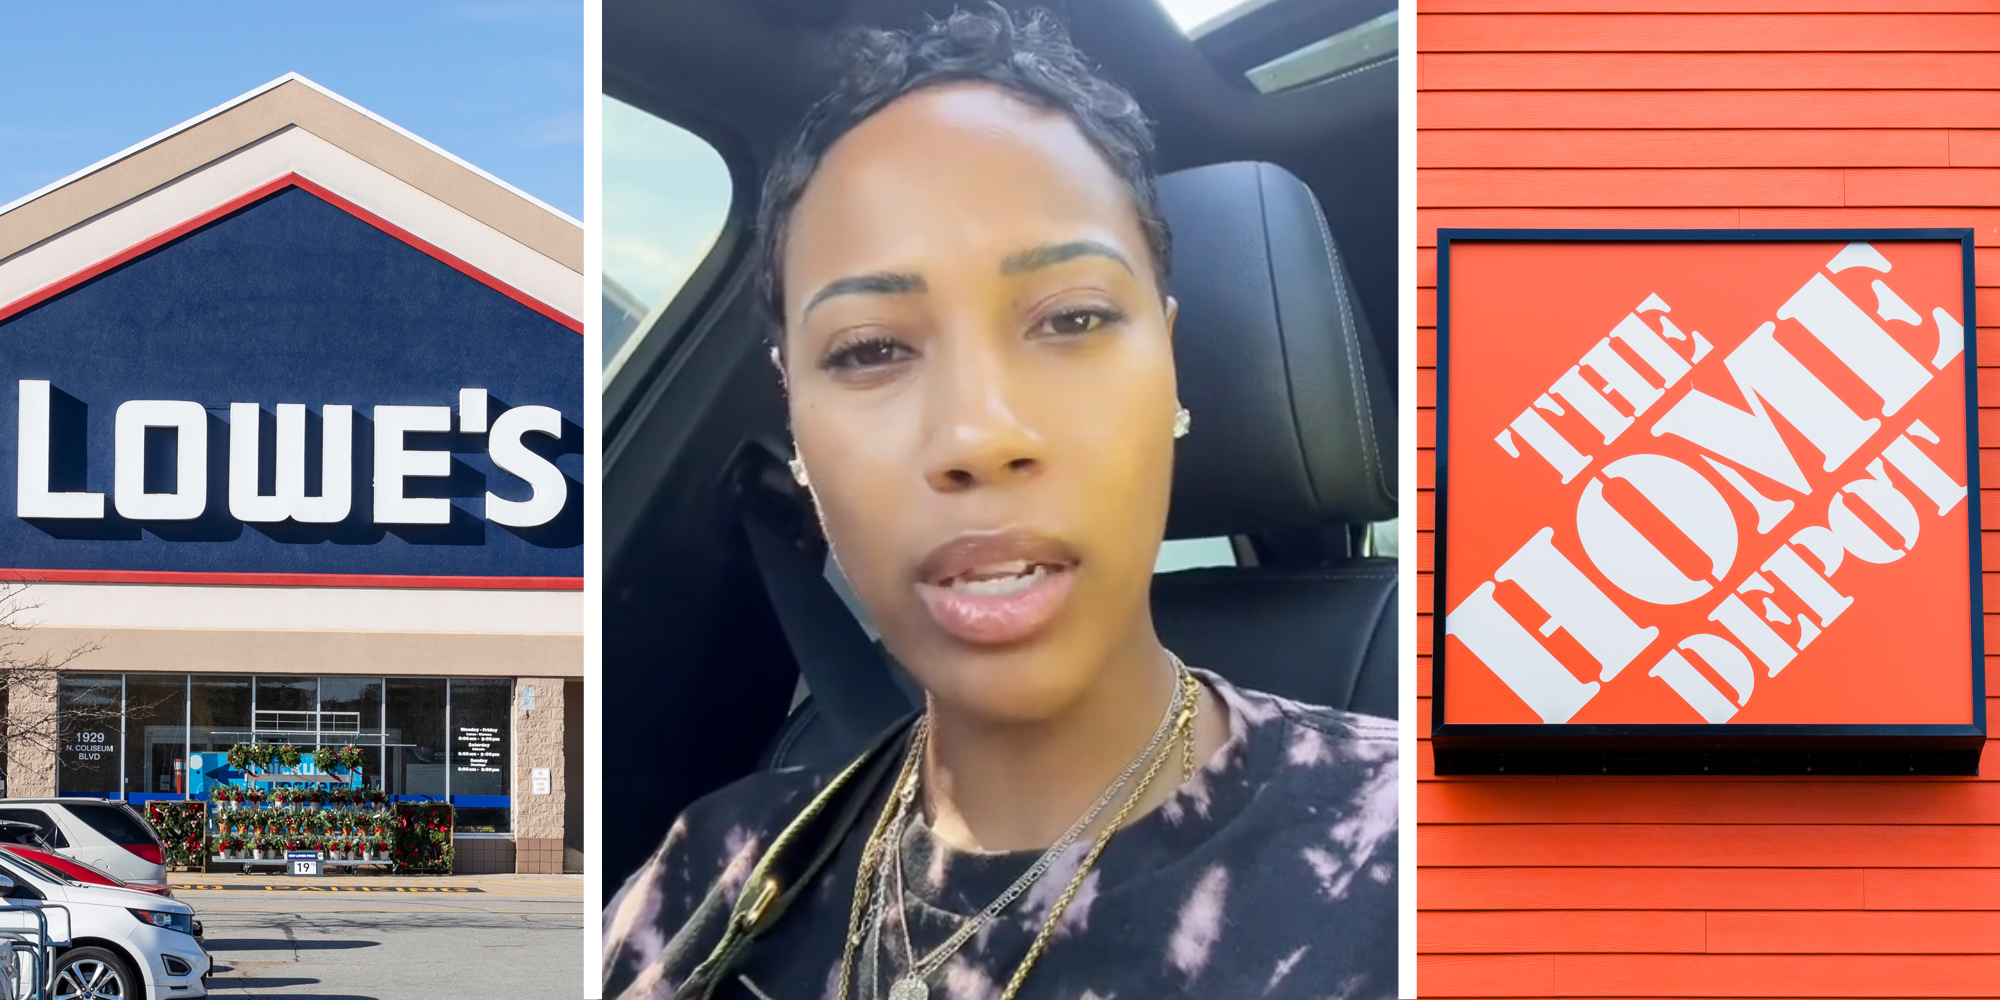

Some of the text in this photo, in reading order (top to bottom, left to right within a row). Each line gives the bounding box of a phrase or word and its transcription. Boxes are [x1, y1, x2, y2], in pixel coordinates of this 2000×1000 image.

[1494, 292, 1714, 485] THE
[17, 379, 567, 527] LOWE'S
[1445, 241, 1964, 724] HOME
[1648, 418, 1967, 724] DEPOT
[75, 744, 114, 752] COLISEUM
[76, 732, 105, 743] 1929
[79, 752, 101, 760] BLVD
[297, 862, 310, 873] 19
